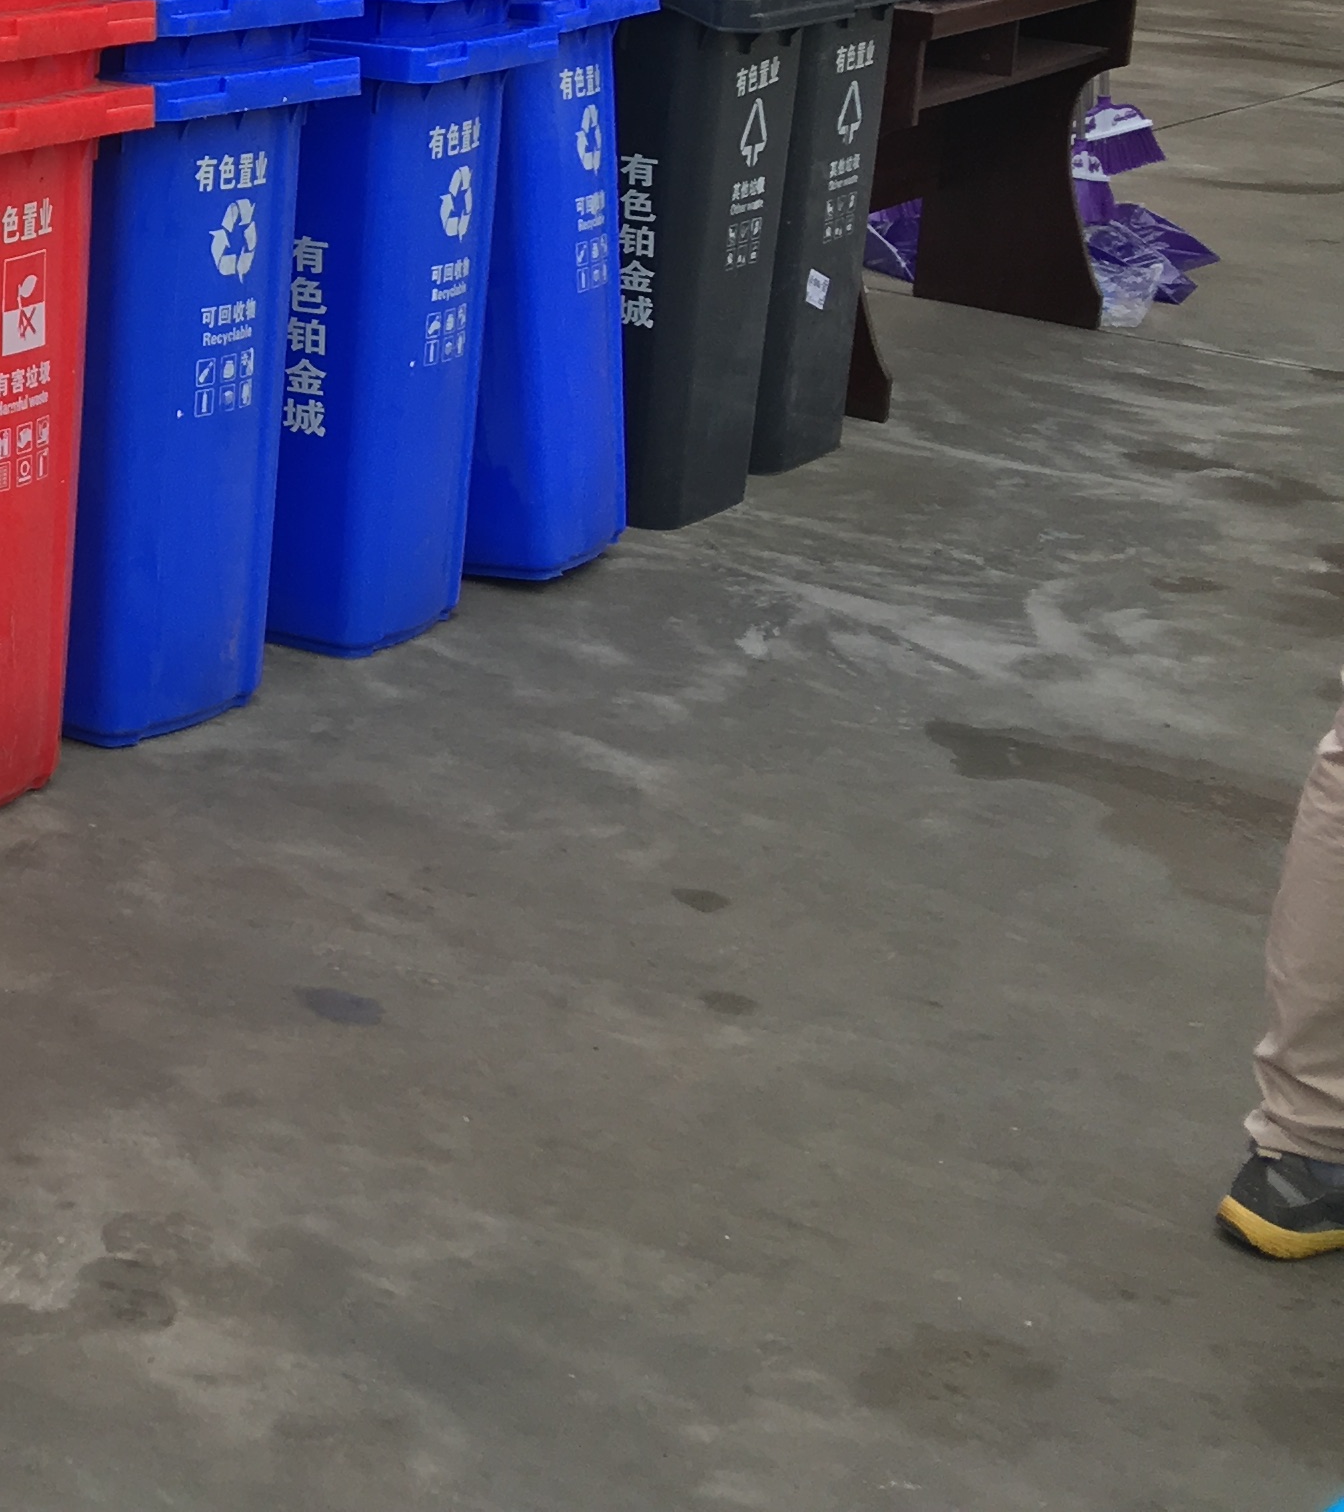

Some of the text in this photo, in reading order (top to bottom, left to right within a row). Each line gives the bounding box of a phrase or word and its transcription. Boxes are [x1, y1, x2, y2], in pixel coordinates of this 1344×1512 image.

[736, 55, 780, 97] 有色置业
[836, 40, 875, 73] 有色置业
[194, 150, 269, 192] 有色置业
[619, 153, 659, 329] 有色铂金城
[200, 297, 257, 330] 可回收物
[202, 323, 253, 347] Recyclable
[283, 234, 330, 438] 有色铂金城
